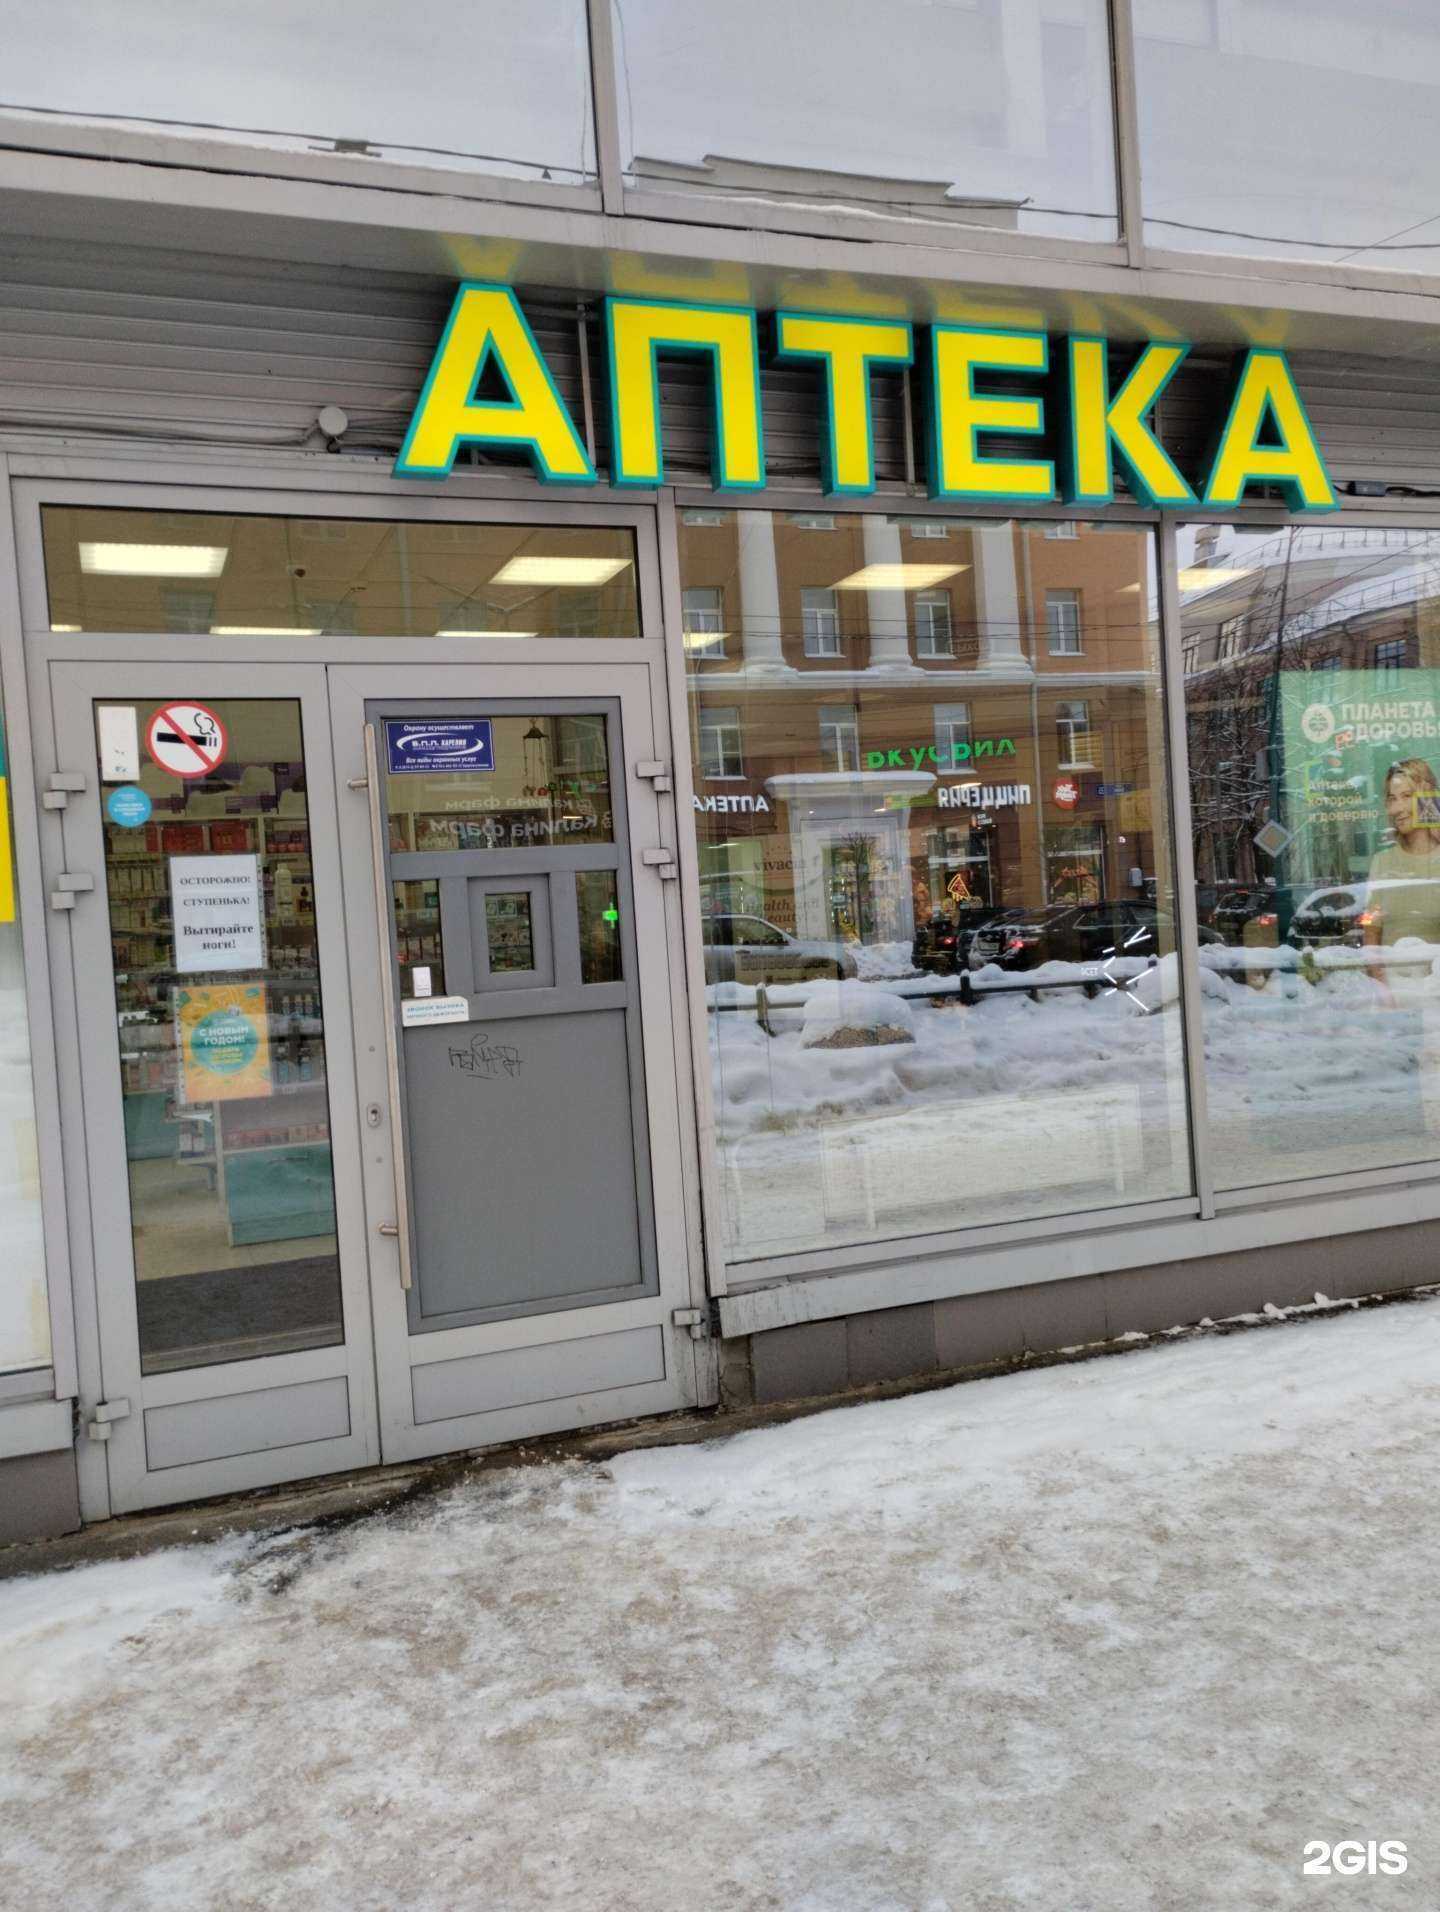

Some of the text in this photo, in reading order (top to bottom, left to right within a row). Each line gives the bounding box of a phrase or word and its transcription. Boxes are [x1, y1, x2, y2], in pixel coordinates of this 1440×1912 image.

[393, 281, 1338, 513] АПТЕКА
[1342, 702, 1435, 720] ПЛАНЕТА
[403, 724, 426, 732] Охрану
[1343, 720, 1440, 741] ДОРОВЬ
[180, 876, 251, 886] ОСТОРОЖНО!
[183, 897, 250, 906] СТУПЕНЬКА!
[183, 924, 254, 937] Вытирайте
[202, 940, 236, 950] ноги!
[199, 1026, 249, 1037] С НОВЫМ
[204, 1036, 246, 1046] ГОДОМ!
